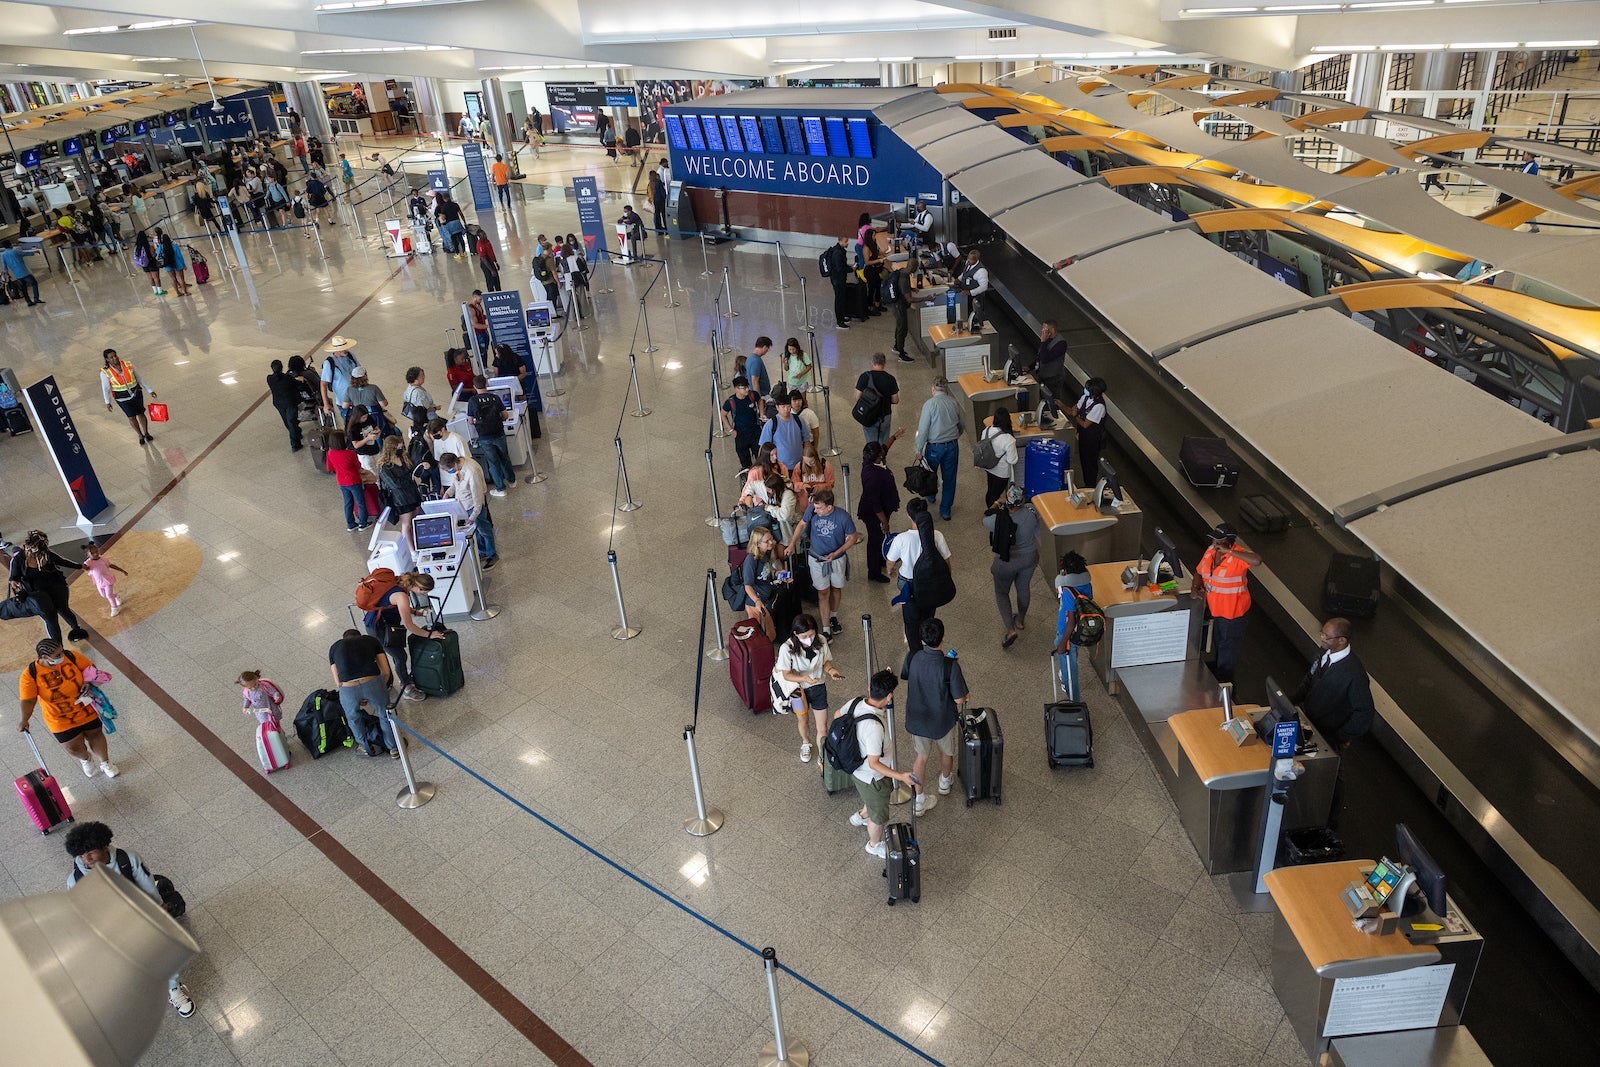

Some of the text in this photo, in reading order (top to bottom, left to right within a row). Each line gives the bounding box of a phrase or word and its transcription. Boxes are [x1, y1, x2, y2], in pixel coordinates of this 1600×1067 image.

[643, 85, 686, 97] SHOP
[684, 156, 870, 186] WELCOME ABOARD
[52, 395, 74, 442] DELTA
